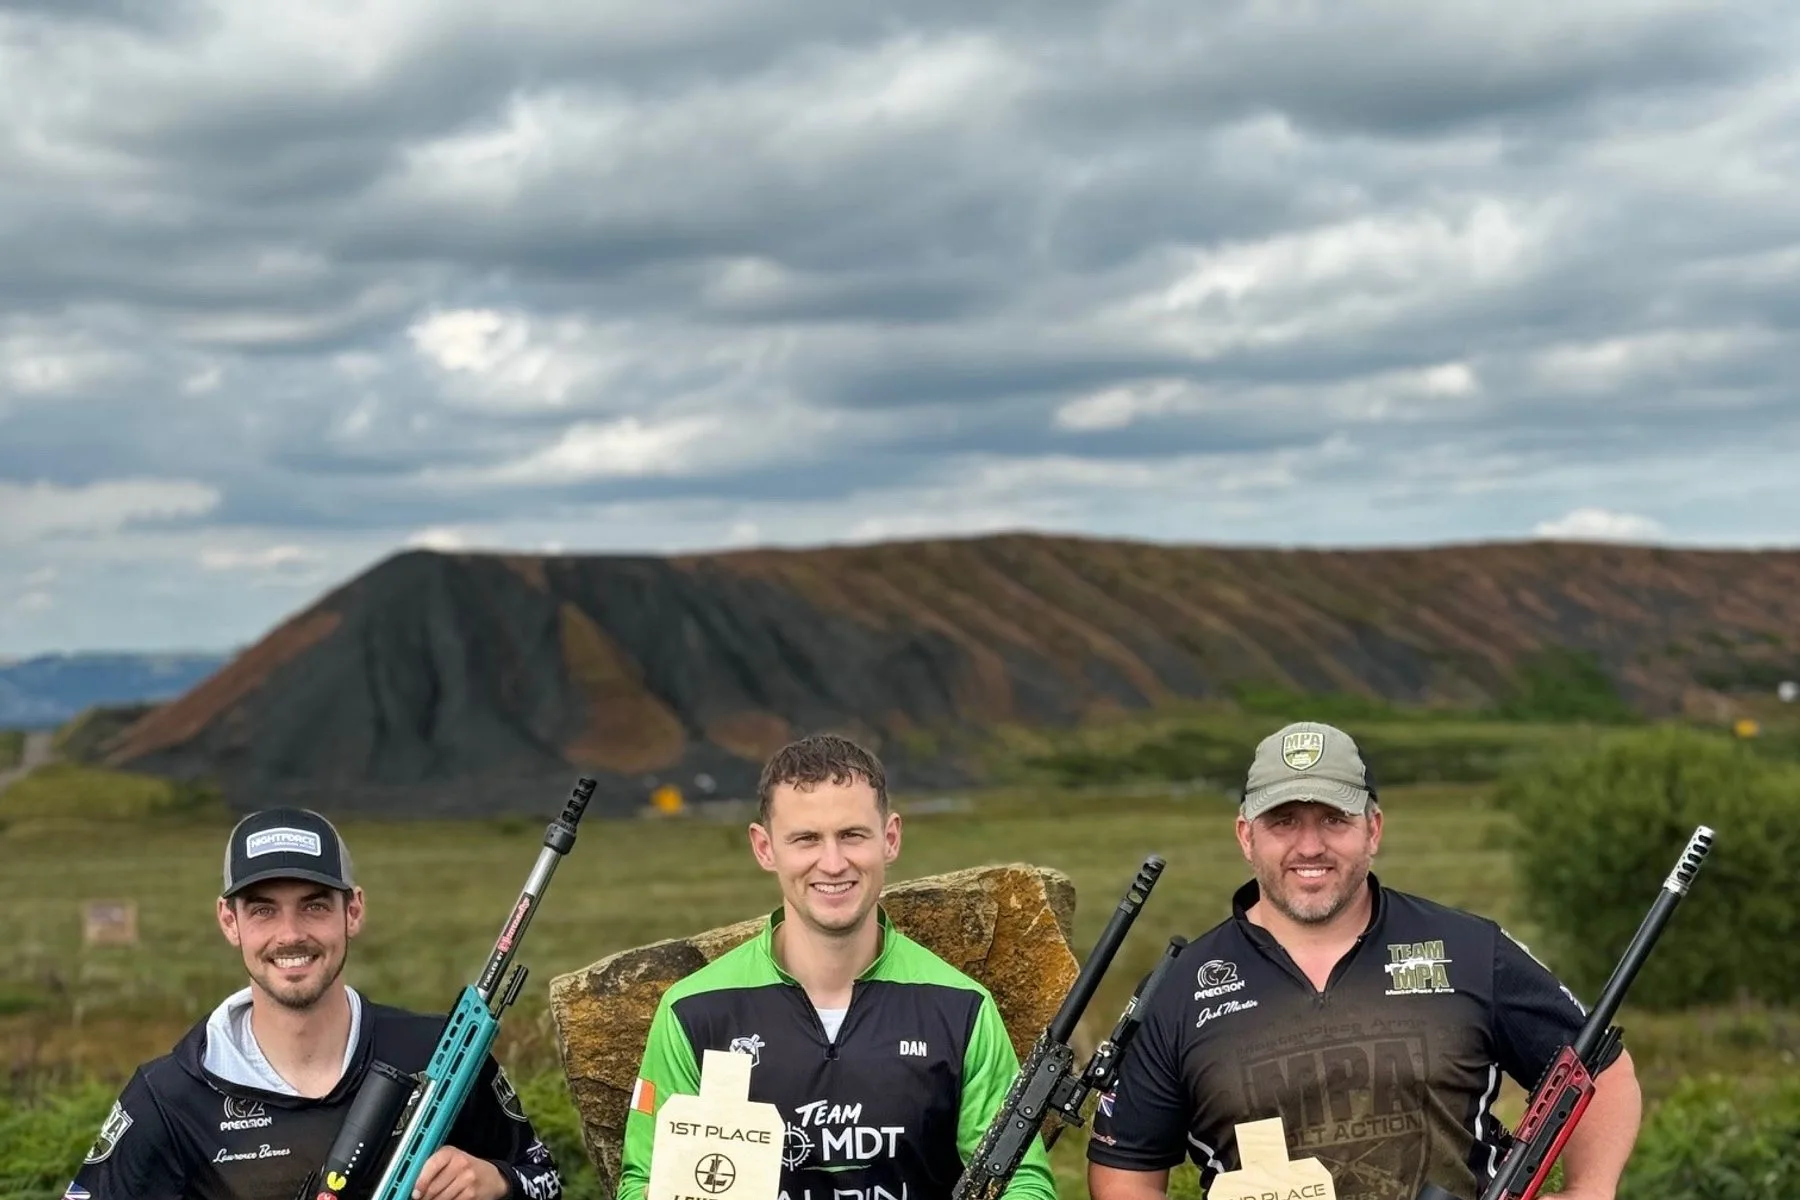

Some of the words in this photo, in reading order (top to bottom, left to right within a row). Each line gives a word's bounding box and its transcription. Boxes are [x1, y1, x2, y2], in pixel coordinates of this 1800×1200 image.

[1285, 734, 1321, 748] MPA
[251, 833, 316, 848] NIGHTFORCE
[1387, 940, 1445, 962] TEAM
[1391, 963, 1450, 990] MPA
[1194, 980, 1245, 1000] PRECISION
[899, 1040, 927, 1057] DAN
[220, 1116, 272, 1131] PRECISION
[795, 1099, 862, 1128] TEAM
[669, 1121, 701, 1137] 1ST
[705, 1125, 771, 1144] PLACE
[1334, 1112, 1423, 1140] ACTION
[821, 1126, 905, 1161] MDT
